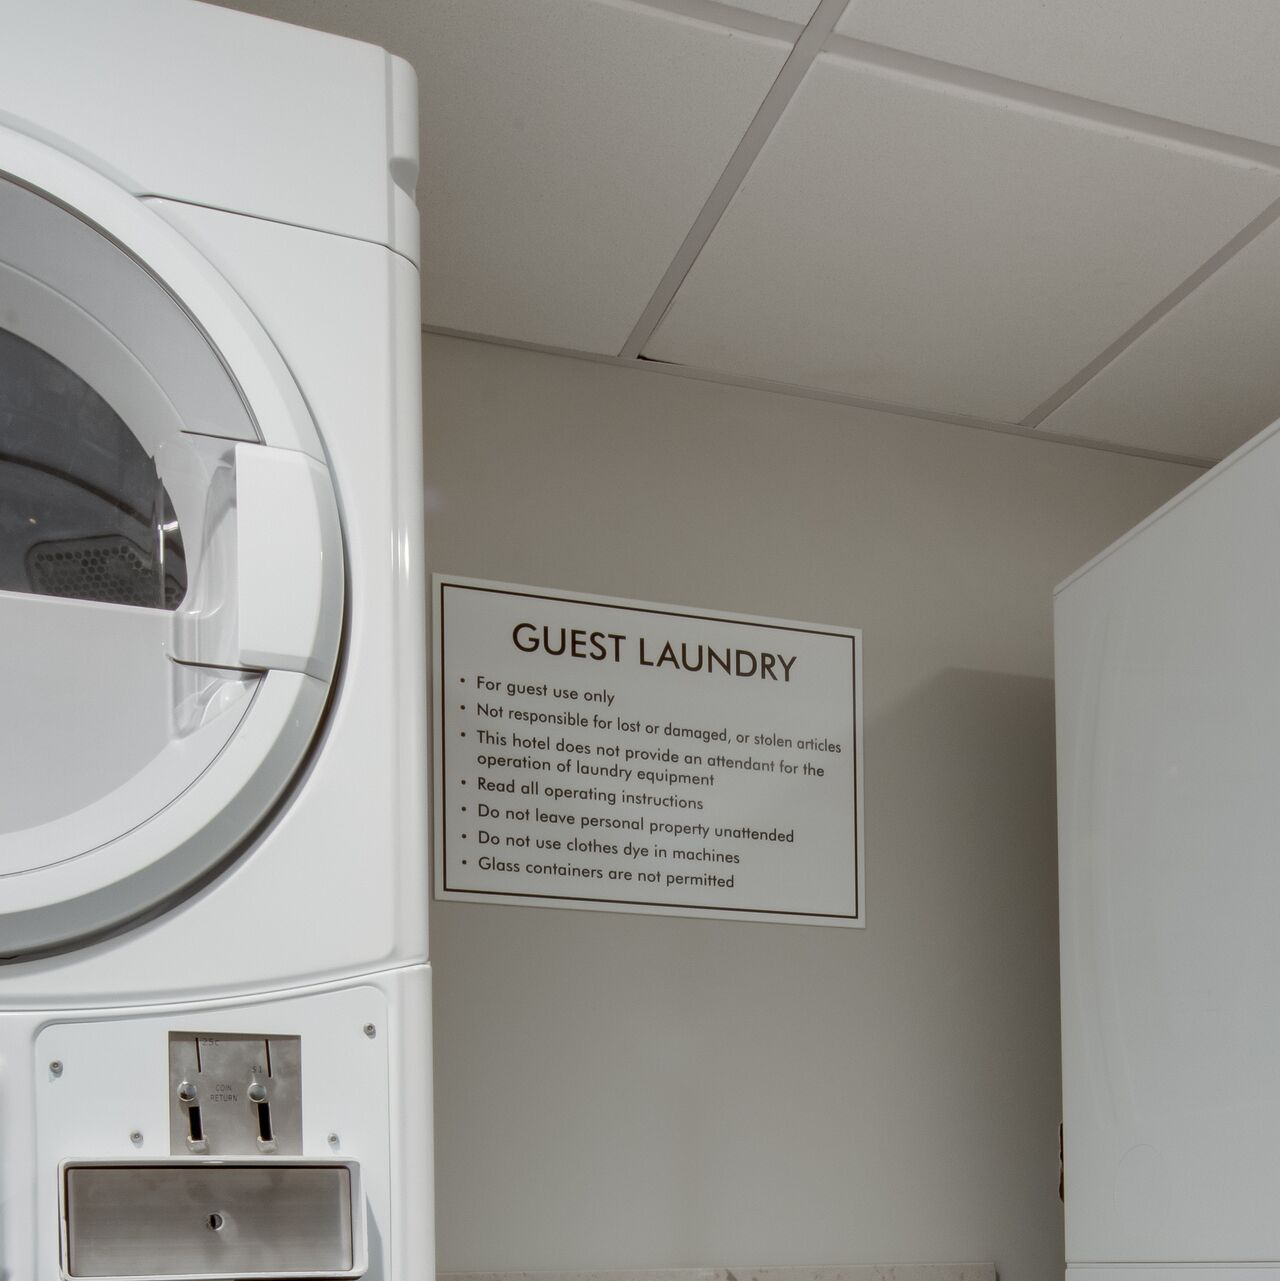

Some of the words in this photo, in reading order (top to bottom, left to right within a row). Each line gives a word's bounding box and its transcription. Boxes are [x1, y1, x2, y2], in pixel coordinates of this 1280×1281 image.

[512, 622, 626, 662] GUEST
[639, 637, 797, 682] LAUNDRY
[477, 675, 502, 691] For
[506, 683, 548, 697] guest
[553, 688, 579, 700] use
[583, 689, 615, 707] only
[477, 702, 503, 718] Not
[508, 709, 589, 728] responsible
[593, 714, 613, 730] for
[617, 717, 641, 733] lost
[645, 725, 660, 736] or
[664, 722, 731, 744] damaged,
[736, 733, 750, 744] or
[754, 732, 793, 749] stolen
[797, 738, 842, 754] articles
[477, 729, 507, 746] This
[512, 733, 550, 751] hotel
[556, 738, 591, 755] does
[596, 744, 620, 757] not
[625, 748, 679, 763] provide
[684, 753, 702, 766] an
[707, 755, 775, 772] attendant
[779, 760, 799, 775] for
[803, 762, 825, 777] the
[477, 754, 551, 771] operation
[556, 759, 572, 773] of
[576, 760, 632, 782] laundry
[637, 768, 714, 786] equipment
[477, 776, 515, 793] Read
[520, 781, 539, 796] all
[544, 786, 616, 806] operating
[622, 790, 704, 810] instructions
[478, 803, 500, 819] Do
[505, 808, 530, 821] not
[535, 808, 575, 825] leave
[580, 816, 644, 831] personal
[649, 820, 710, 839] property
[714, 826, 795, 843] unattended
[478, 830, 500, 845] Do
[506, 835, 531, 848] not
[535, 839, 561, 850] use
[566, 837, 618, 855] clothes
[623, 842, 649, 859] dye
[654, 844, 667, 858] in
[672, 848, 740, 864] machines
[478, 856, 521, 873] Glass
[525, 862, 603, 879] containers
[608, 869, 633, 881] are
[638, 871, 662, 883] not
[666, 873, 735, 888] permitted
